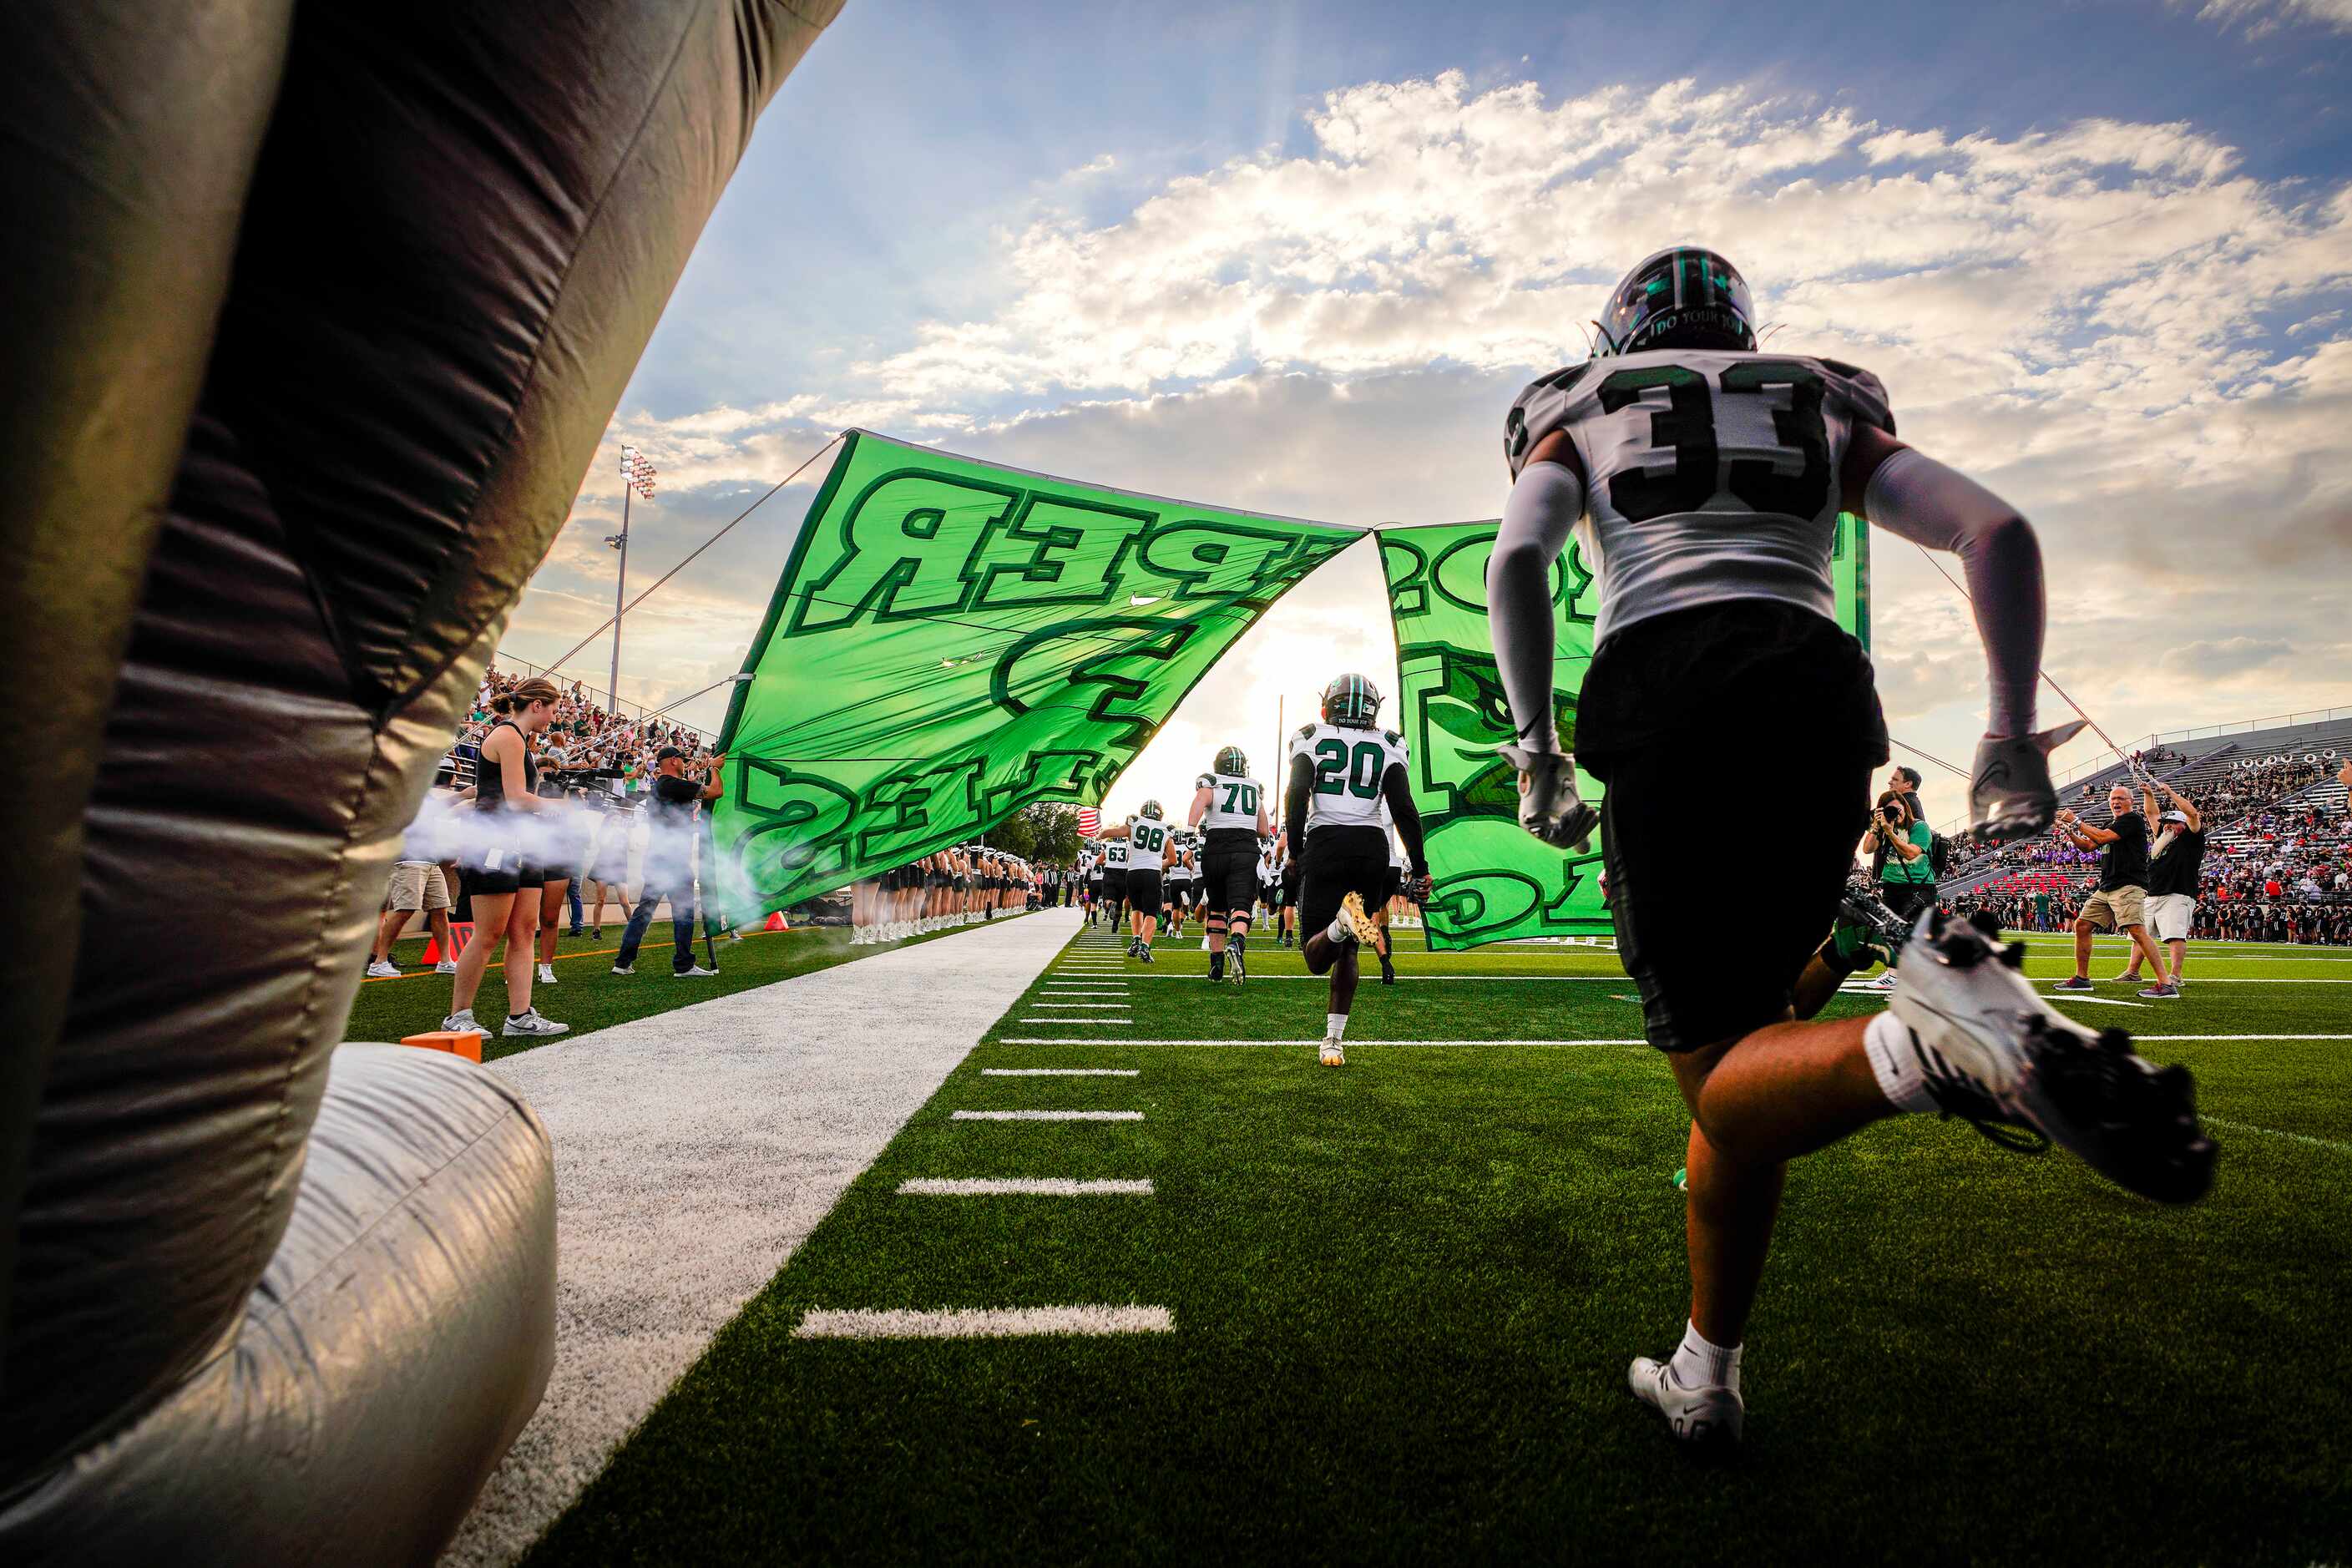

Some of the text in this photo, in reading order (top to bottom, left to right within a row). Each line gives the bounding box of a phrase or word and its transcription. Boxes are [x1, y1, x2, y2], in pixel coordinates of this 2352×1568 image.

[1596, 361, 1831, 524] 33
[1313, 738, 1384, 800] 20
[1221, 783, 1257, 816] 70
[1108, 847, 1126, 862] 63
[1134, 825, 1165, 852] 98
